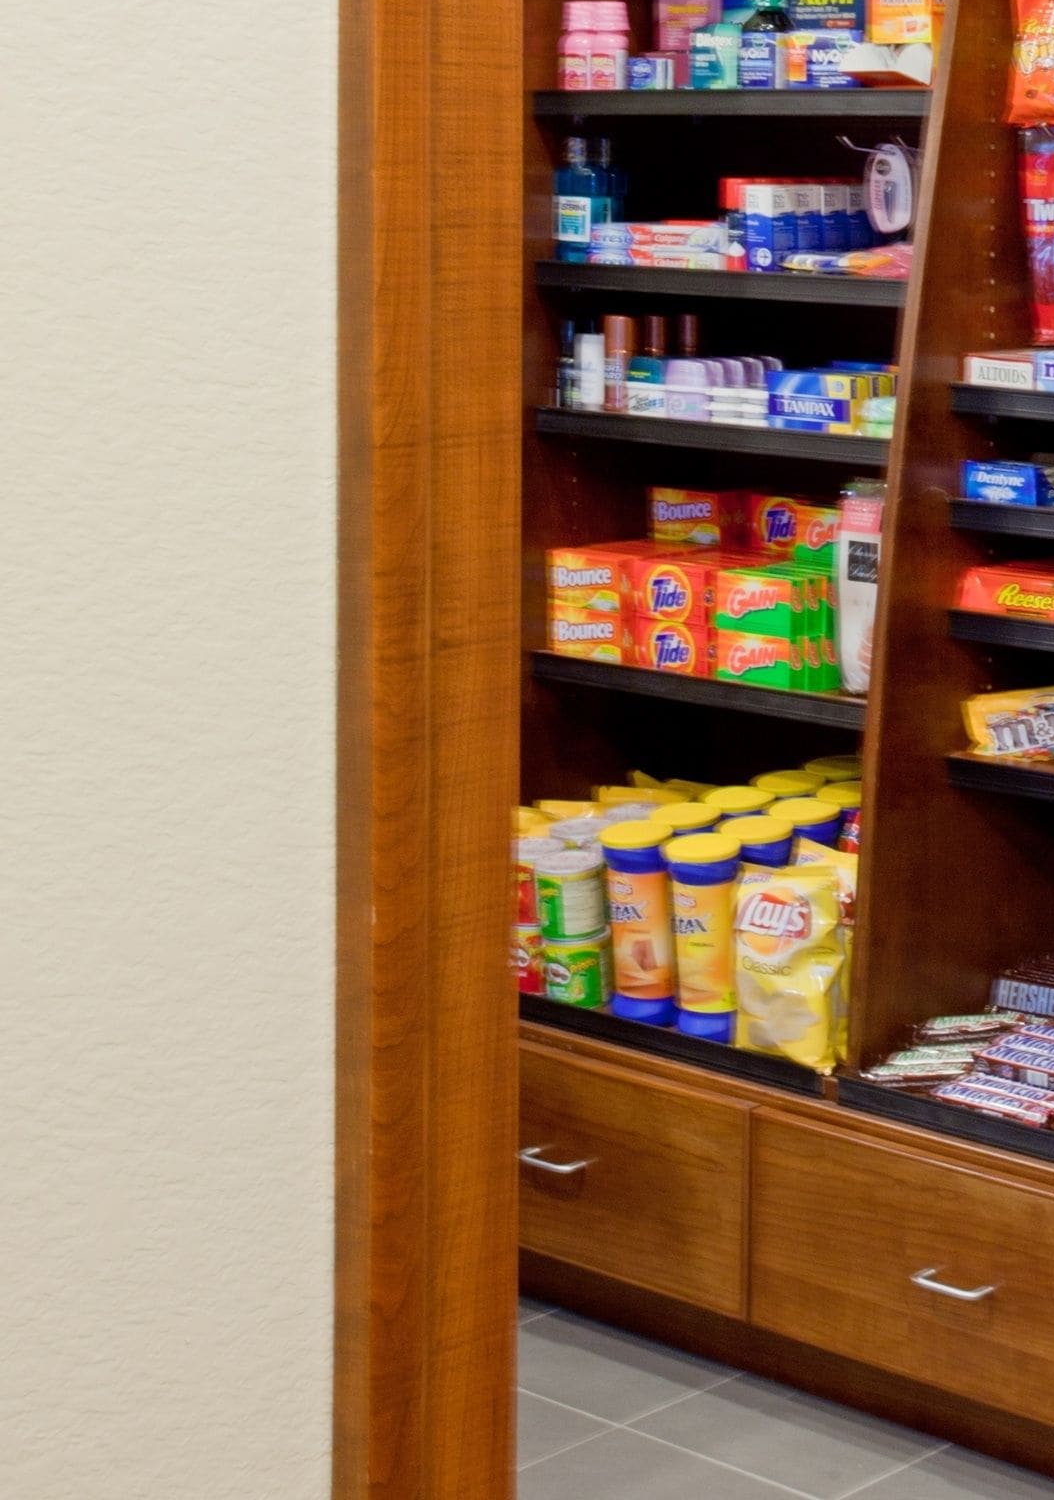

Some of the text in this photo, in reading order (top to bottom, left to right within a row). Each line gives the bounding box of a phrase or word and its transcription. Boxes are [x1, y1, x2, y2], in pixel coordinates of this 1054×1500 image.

[692, 33, 733, 48] Blistex
[977, 366, 1029, 384] ALTOIDS
[782, 399, 835, 417] TAMPAX
[974, 471, 1025, 488] Dentyne
[655, 501, 712, 521] Bounce
[556, 566, 613, 588] Bounce
[651, 577, 688, 612] Tide
[557, 621, 615, 642] Bounce
[655, 633, 691, 668] Tide
[742, 955, 792, 977] Classic
